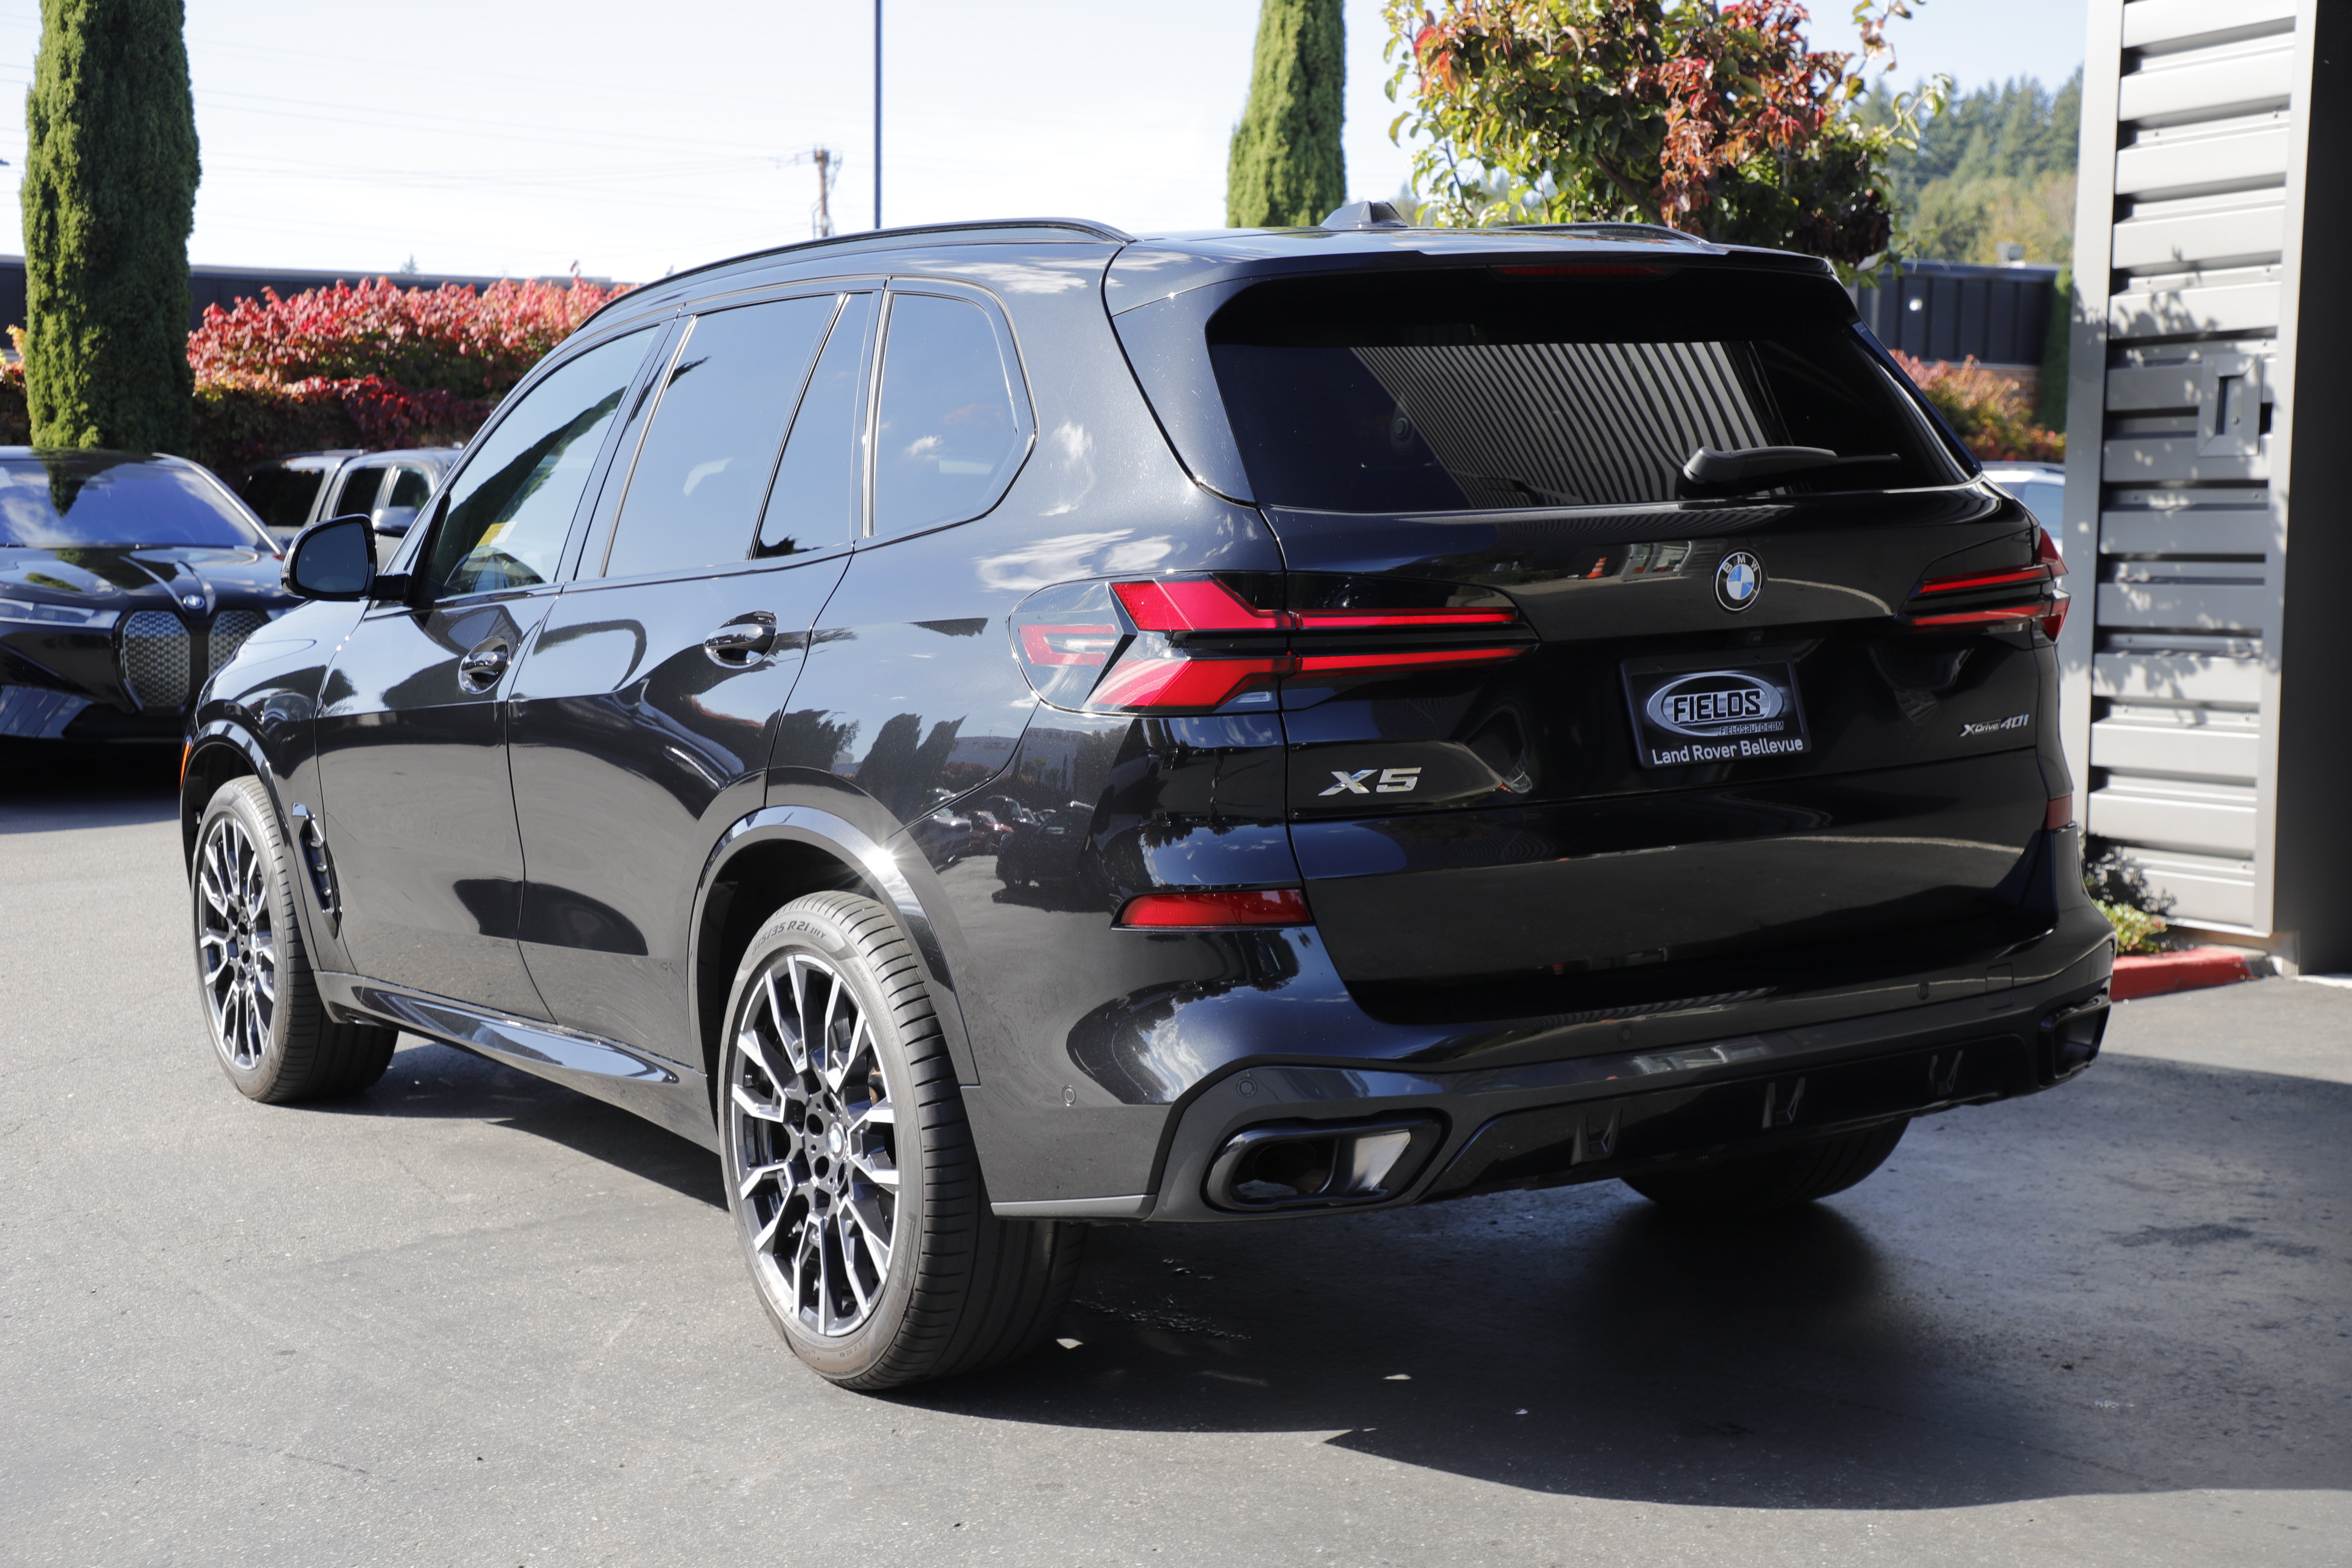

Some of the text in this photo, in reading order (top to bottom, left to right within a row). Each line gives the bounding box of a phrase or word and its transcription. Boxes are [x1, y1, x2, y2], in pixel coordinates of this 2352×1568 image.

[1722, 554, 1759, 574] BMW
[1673, 689, 1761, 723] FIELDS
[1652, 738, 1804, 765] Land Rover Bellevue
[1318, 767, 1422, 796] X5
